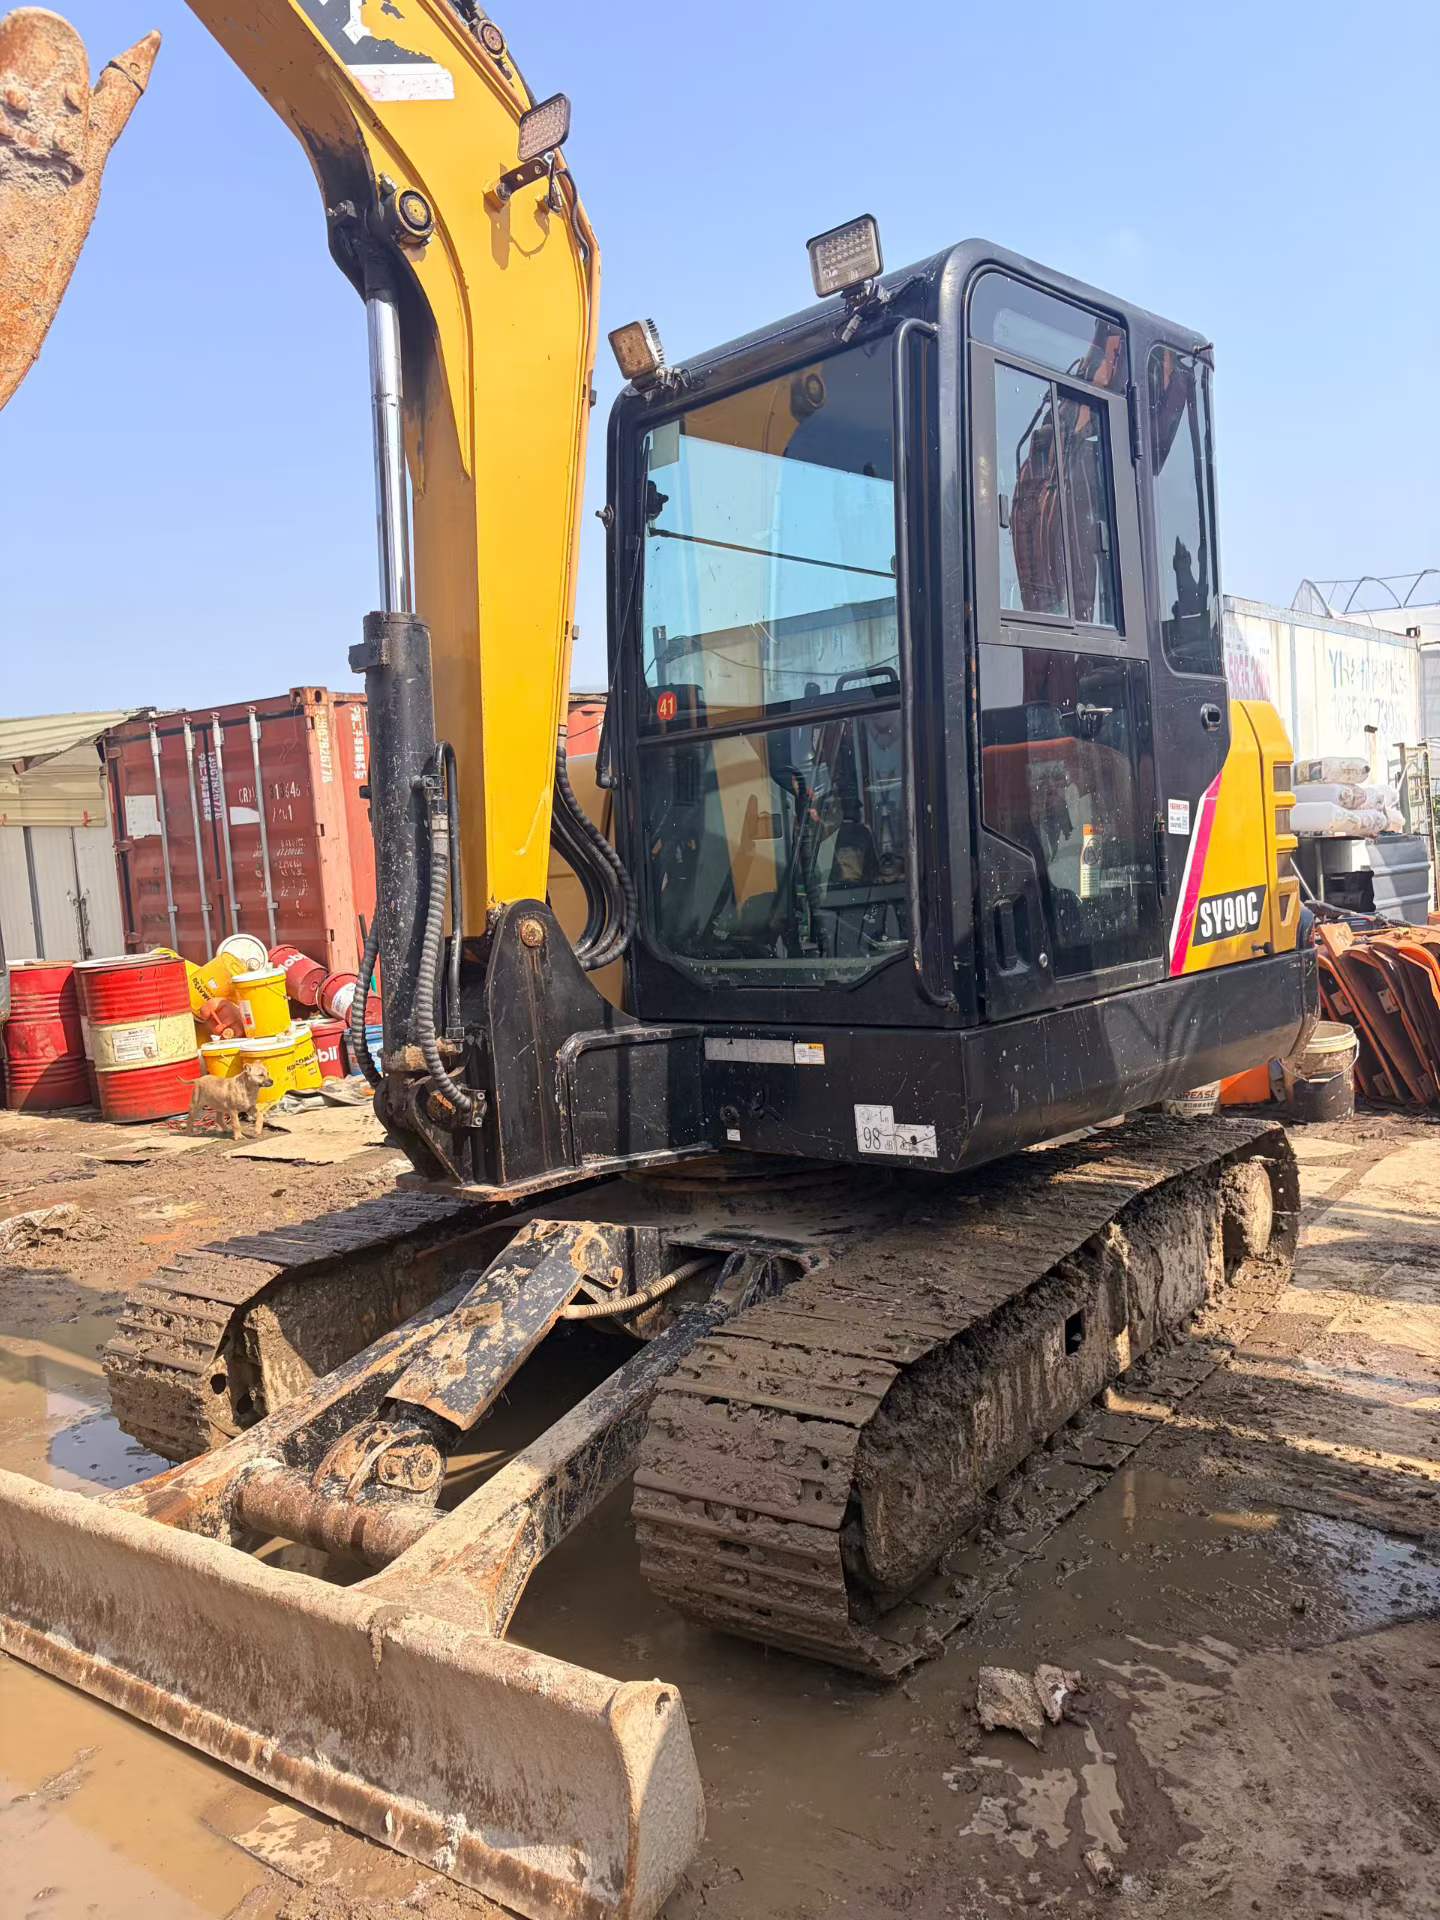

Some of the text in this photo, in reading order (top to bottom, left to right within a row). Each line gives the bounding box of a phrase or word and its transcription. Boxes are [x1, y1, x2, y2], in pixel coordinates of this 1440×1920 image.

[660, 697, 674, 715] 41
[1200, 891, 1259, 938] SY90C
[317, 1046, 338, 1063] bil
[863, 1127, 881, 1150] 98
